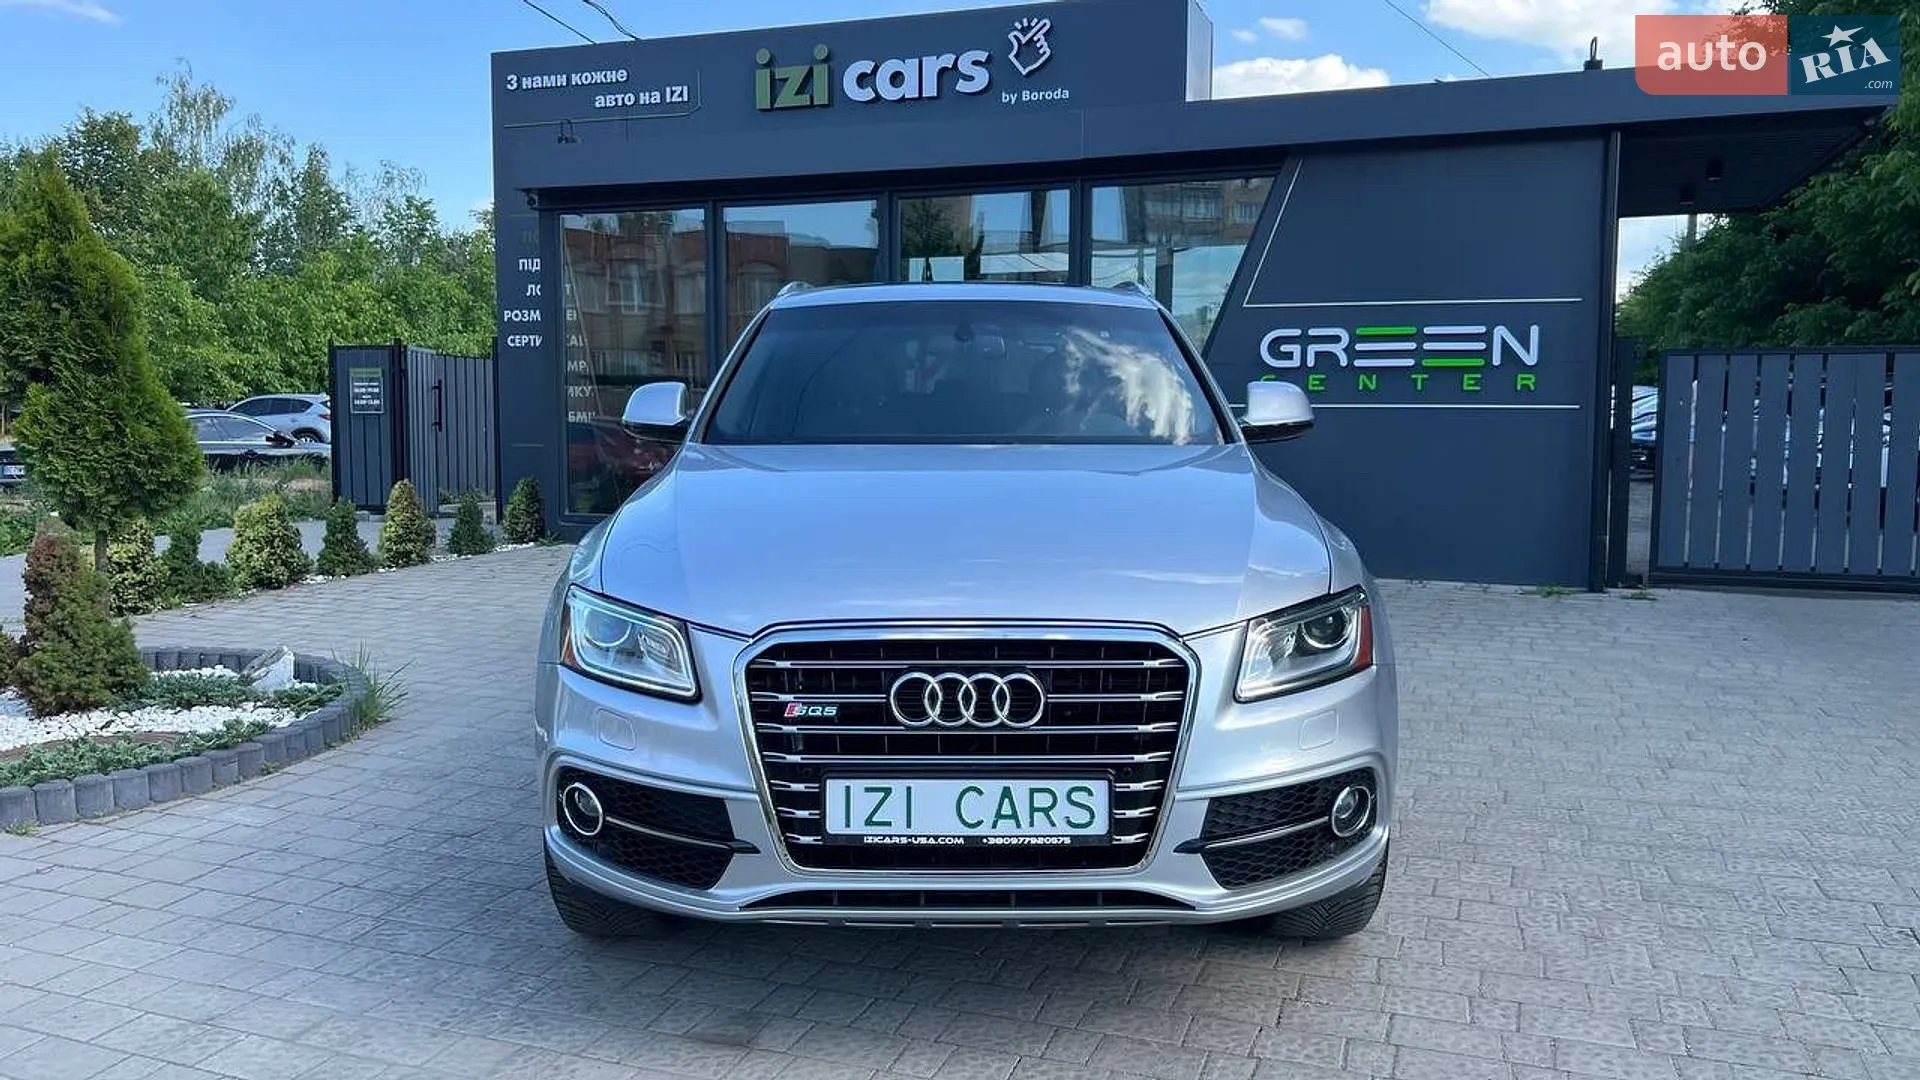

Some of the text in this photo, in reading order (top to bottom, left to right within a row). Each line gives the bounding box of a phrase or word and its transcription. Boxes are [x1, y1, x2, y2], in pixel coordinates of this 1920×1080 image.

[522, 74, 567, 90] нами
[571, 69, 629, 86] кожне
[755, 44, 990, 110] izi cars
[594, 85, 689, 109] авто на IZI
[1002, 88, 1070, 104] by Boroda
[1260, 325, 1540, 368] GREEN
[1260, 374, 1537, 391] ENTER
[843, 785, 1097, 830] IZI CARS
